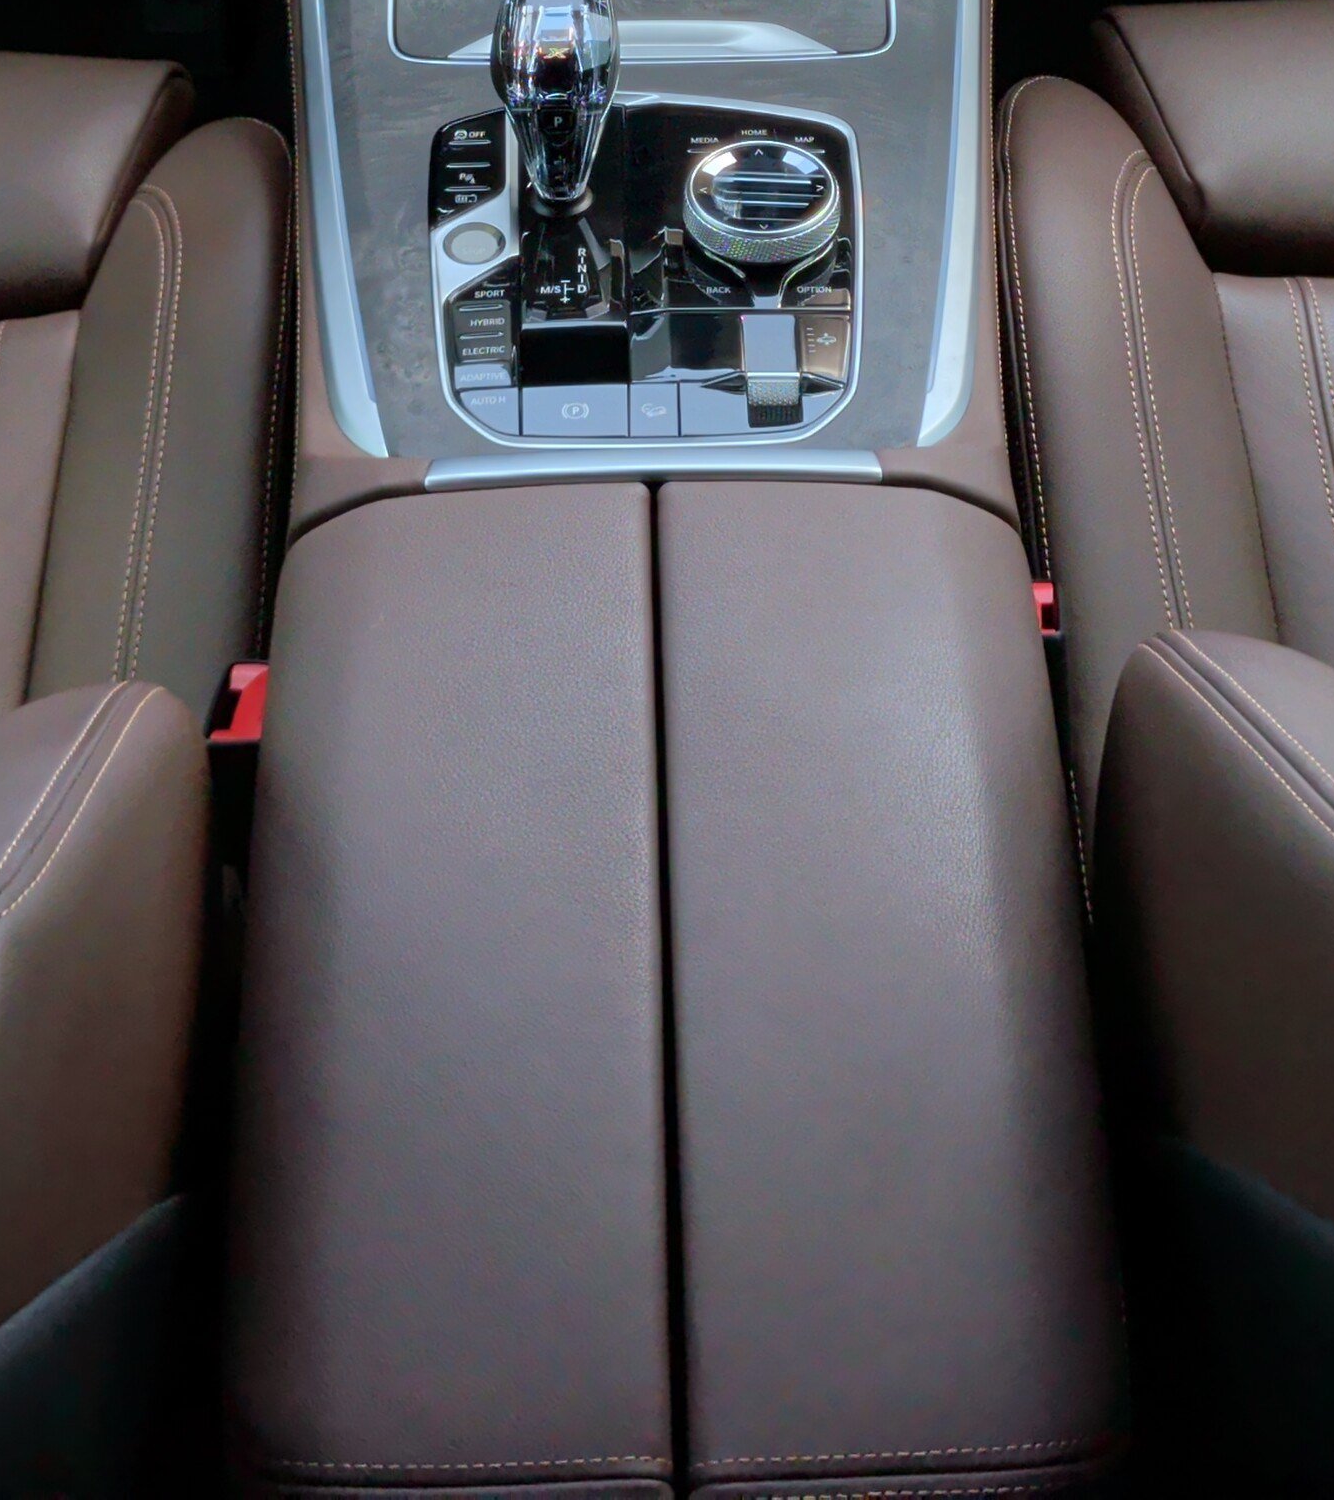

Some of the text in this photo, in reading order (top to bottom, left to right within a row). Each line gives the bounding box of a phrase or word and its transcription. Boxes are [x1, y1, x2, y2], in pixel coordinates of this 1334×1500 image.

[553, 116, 563, 127] P
[468, 130, 486, 139] OFF
[741, 128, 768, 136] HOME
[690, 136, 719, 145] MEDIA
[795, 135, 815, 143] MAP
[577, 247, 587, 257] R
[577, 264, 587, 273] N
[540, 285, 561, 294] M/S
[577, 284, 587, 294] D
[706, 286, 731, 295] BACK
[796, 286, 833, 295] OPTION
[474, 289, 505, 299] SPORT
[470, 318, 505, 327] HYBRID
[462, 345, 506, 356] ELECTRIC
[460, 372, 506, 382] ADAPTIVE
[470, 395, 497, 406] AUTO
